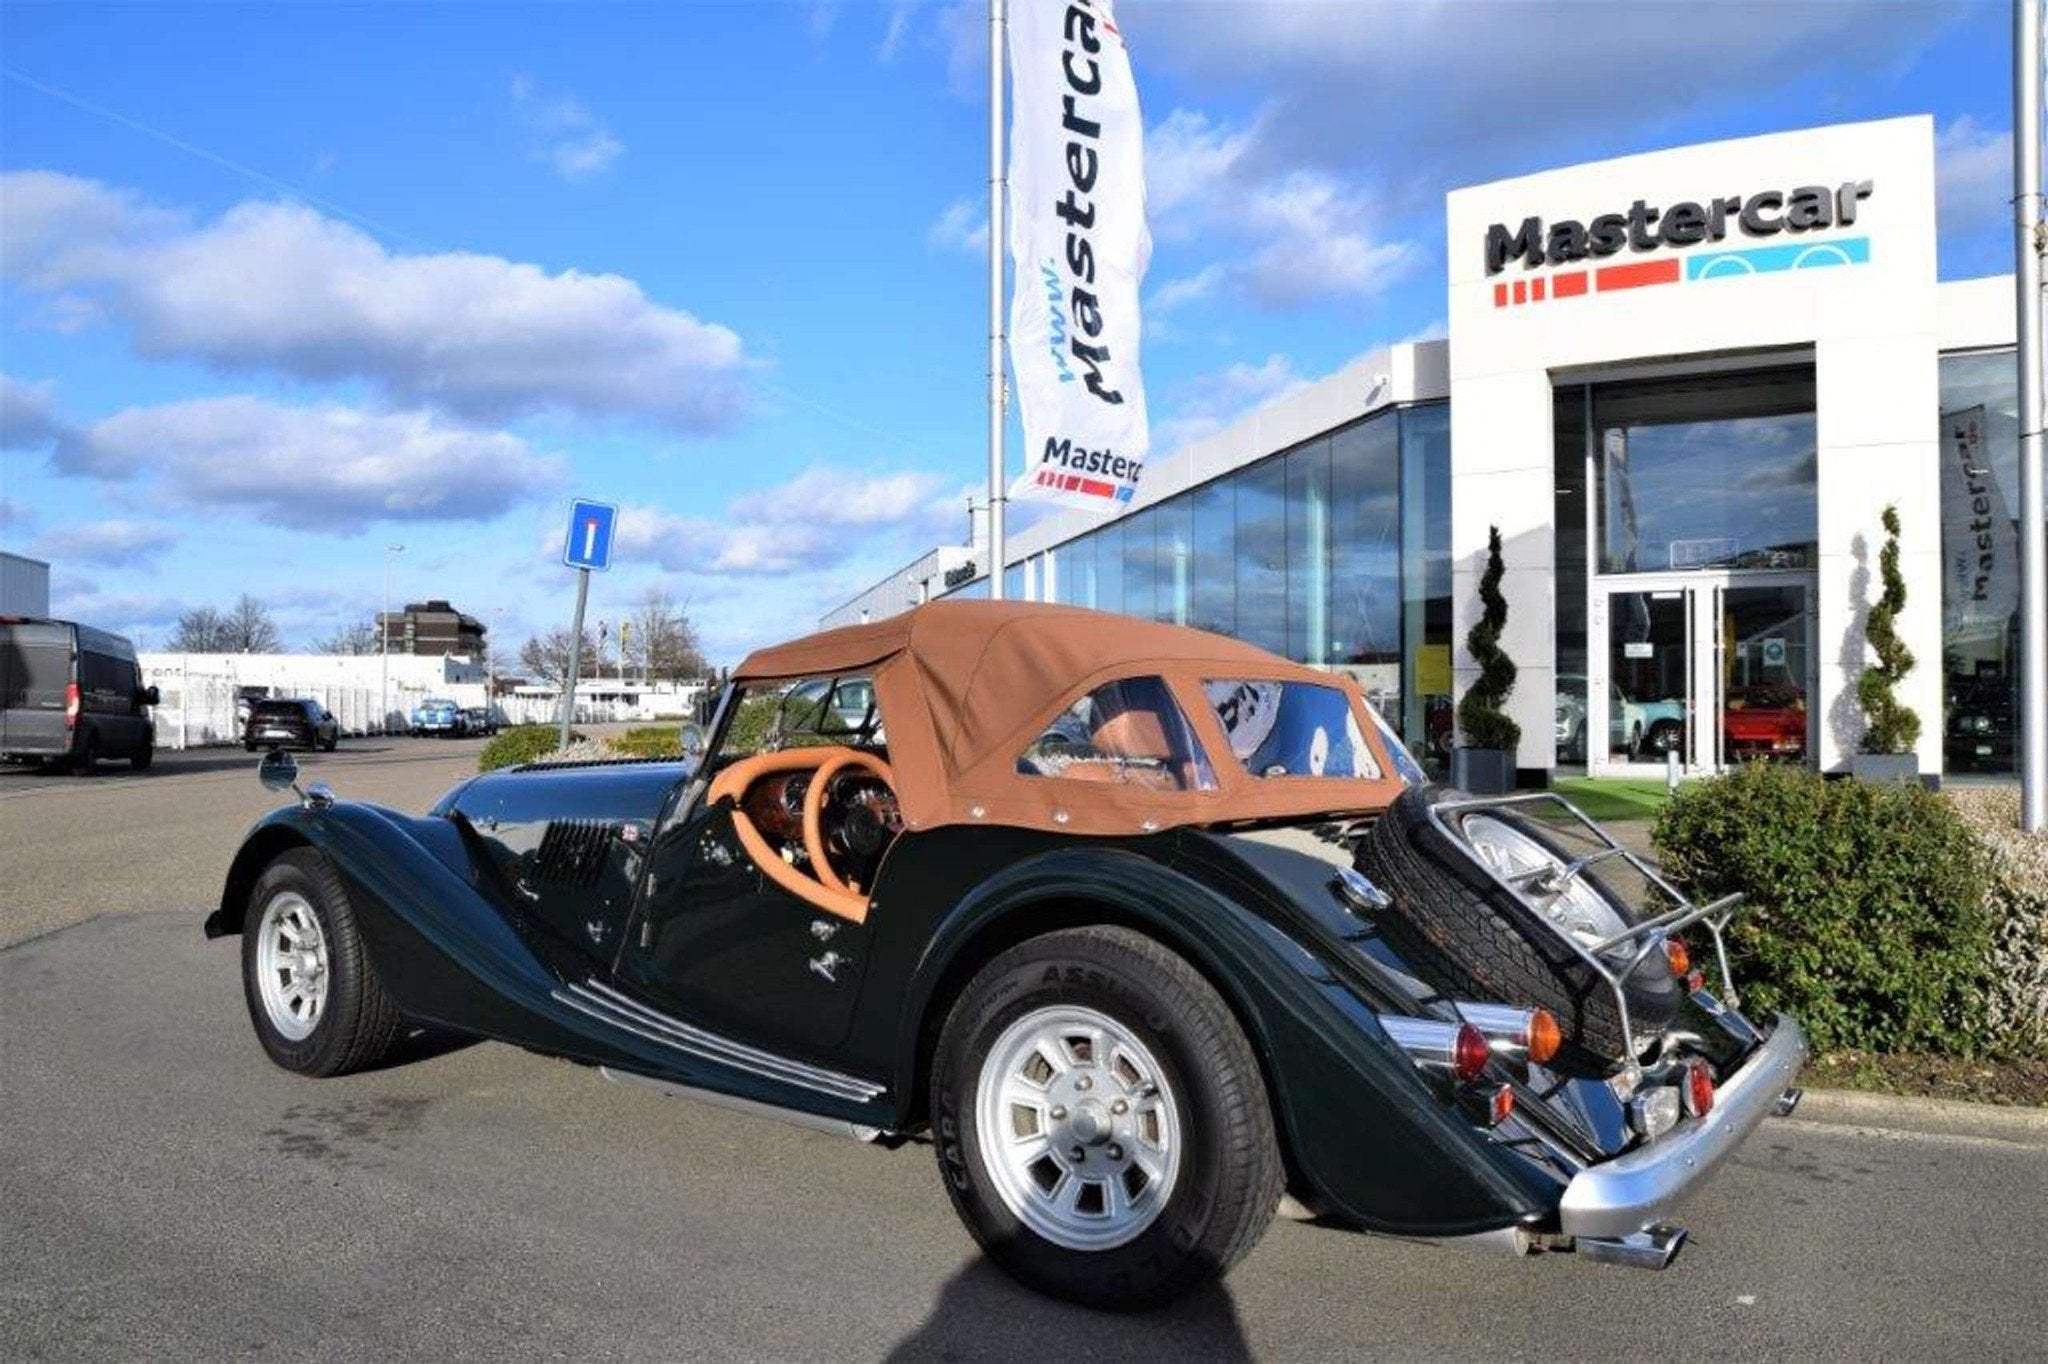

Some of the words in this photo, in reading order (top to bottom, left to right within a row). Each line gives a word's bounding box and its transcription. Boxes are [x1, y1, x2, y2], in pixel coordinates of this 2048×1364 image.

[1056, 0, 1125, 404] Masterca
[1484, 179, 1874, 277] Mastercar
[1040, 257, 1076, 383] www.
